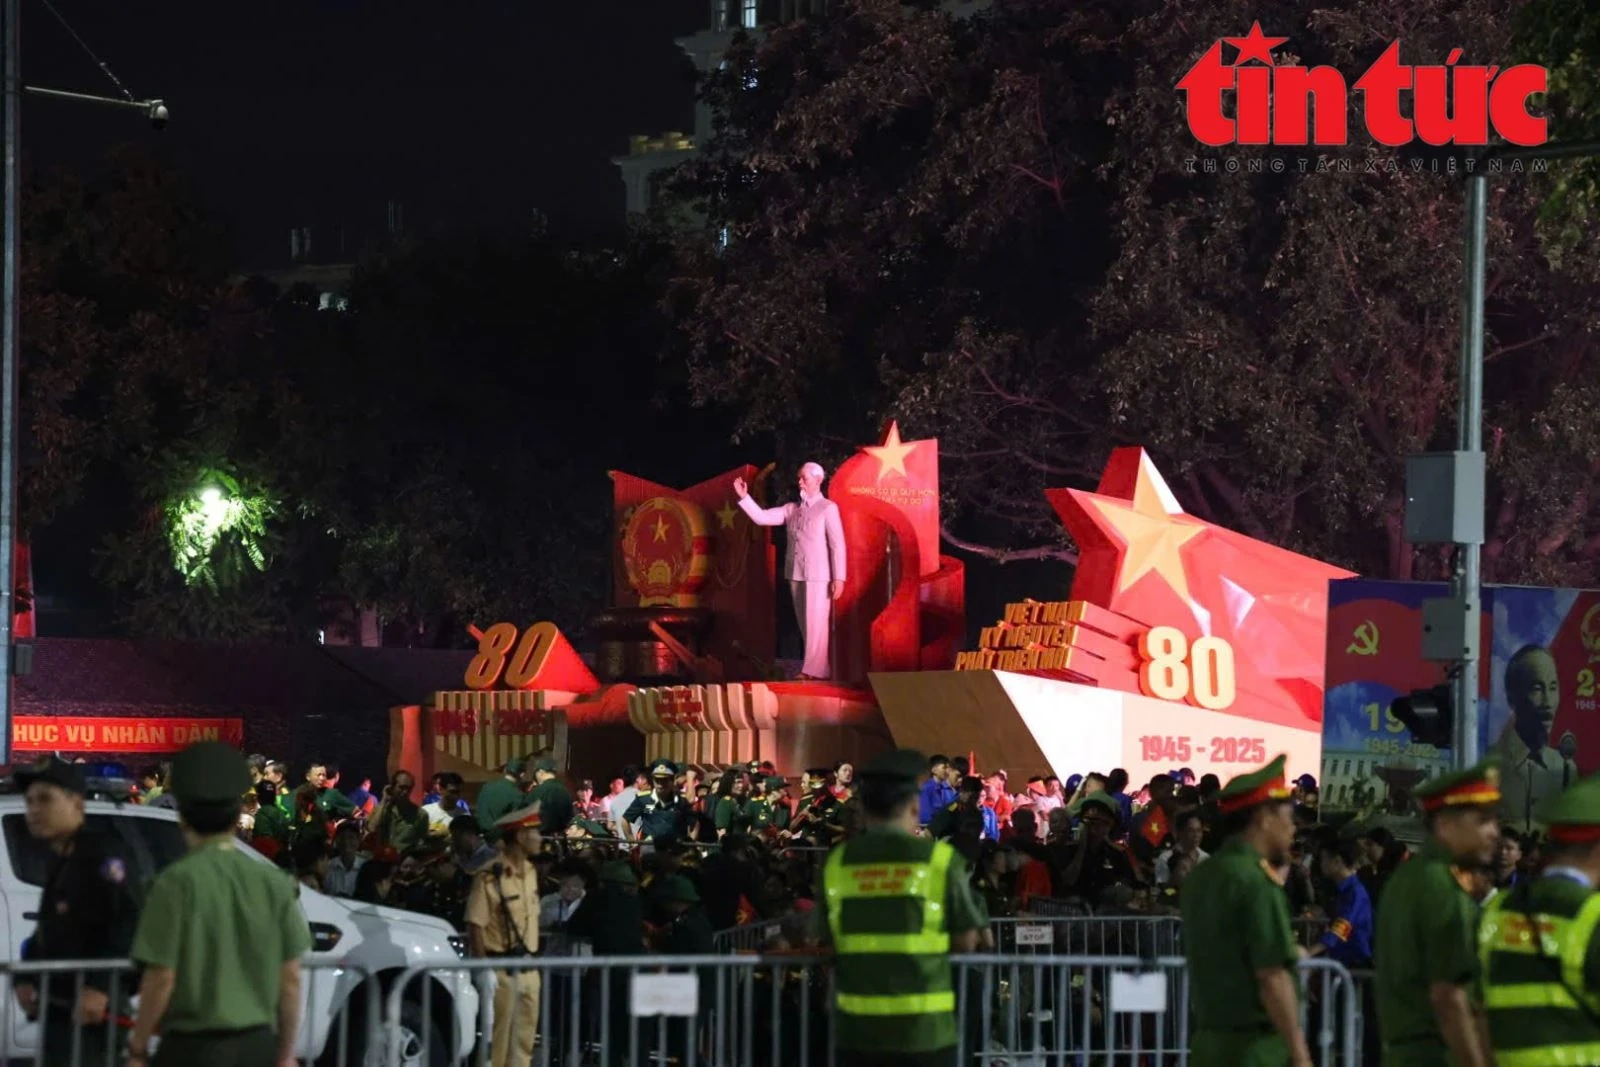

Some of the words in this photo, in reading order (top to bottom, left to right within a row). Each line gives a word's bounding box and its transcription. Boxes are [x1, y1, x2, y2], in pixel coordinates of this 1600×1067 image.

[464, 621, 558, 689] 80
[1138, 625, 1236, 710] 80
[13, 724, 59, 746] HỤC
[66, 725, 95, 747] VỤ
[103, 722, 165, 744] NHÂN
[173, 723, 219, 744] DÂN
